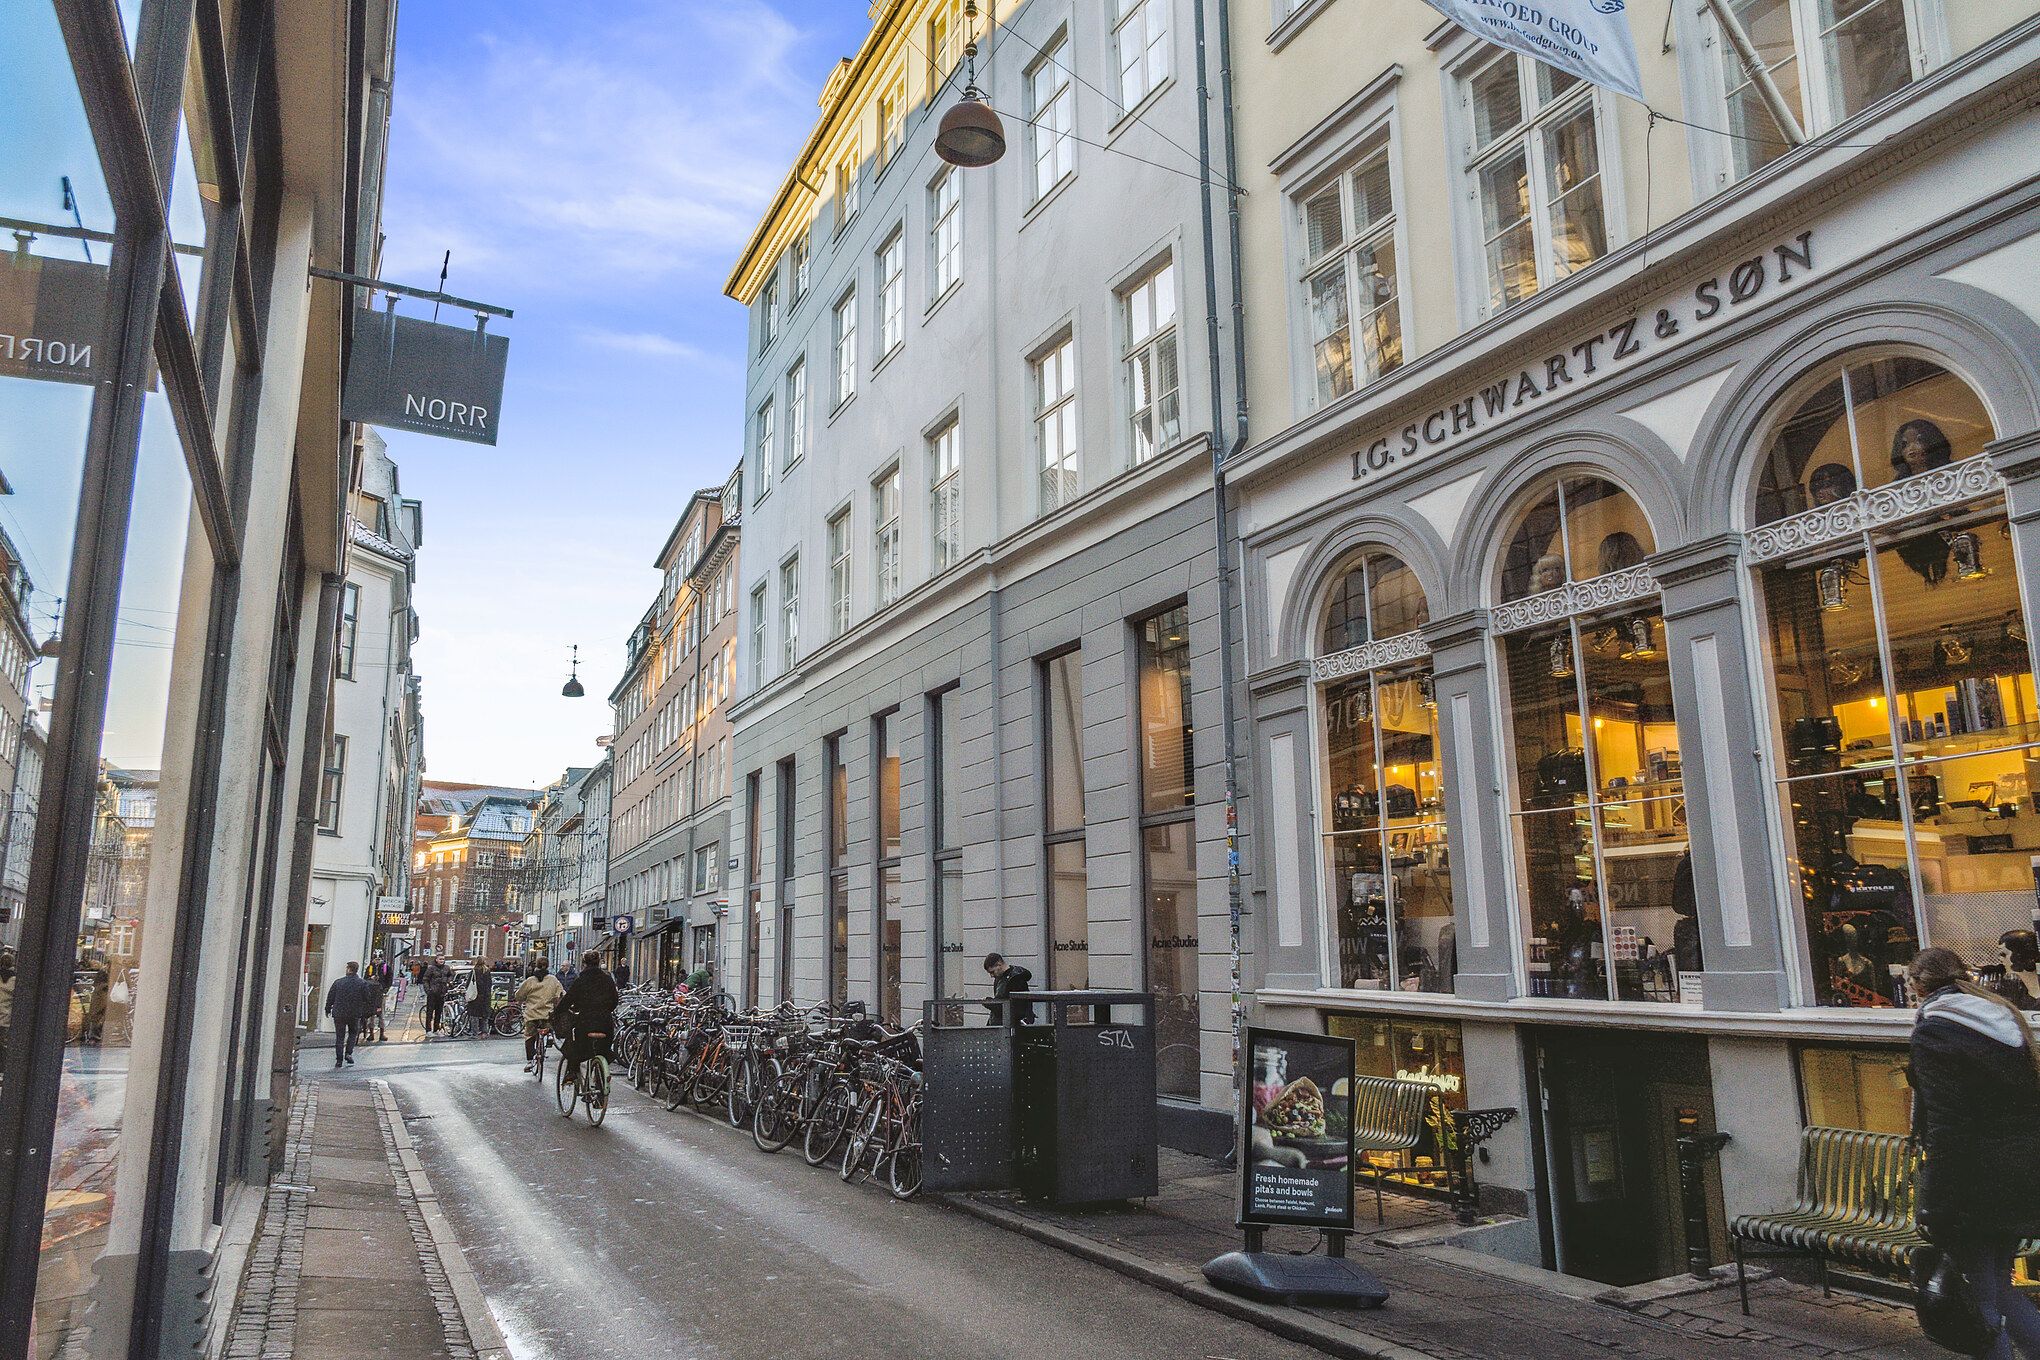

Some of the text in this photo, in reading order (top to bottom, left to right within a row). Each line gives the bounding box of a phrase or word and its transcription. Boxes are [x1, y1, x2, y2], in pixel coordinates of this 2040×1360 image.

[1350, 230, 1812, 481] I.G. SCHWARTZ & SØN
[405, 393, 488, 428] NORR
[381, 912, 411, 920] YELLOW
[1053, 940, 1069, 951] Acne
[1152, 935, 1172, 949] Acne
[1255, 1173, 1319, 1187] Fresh homemade
[1275, 1186, 1290, 1195] and
[1292, 1186, 1314, 1197] bowls
